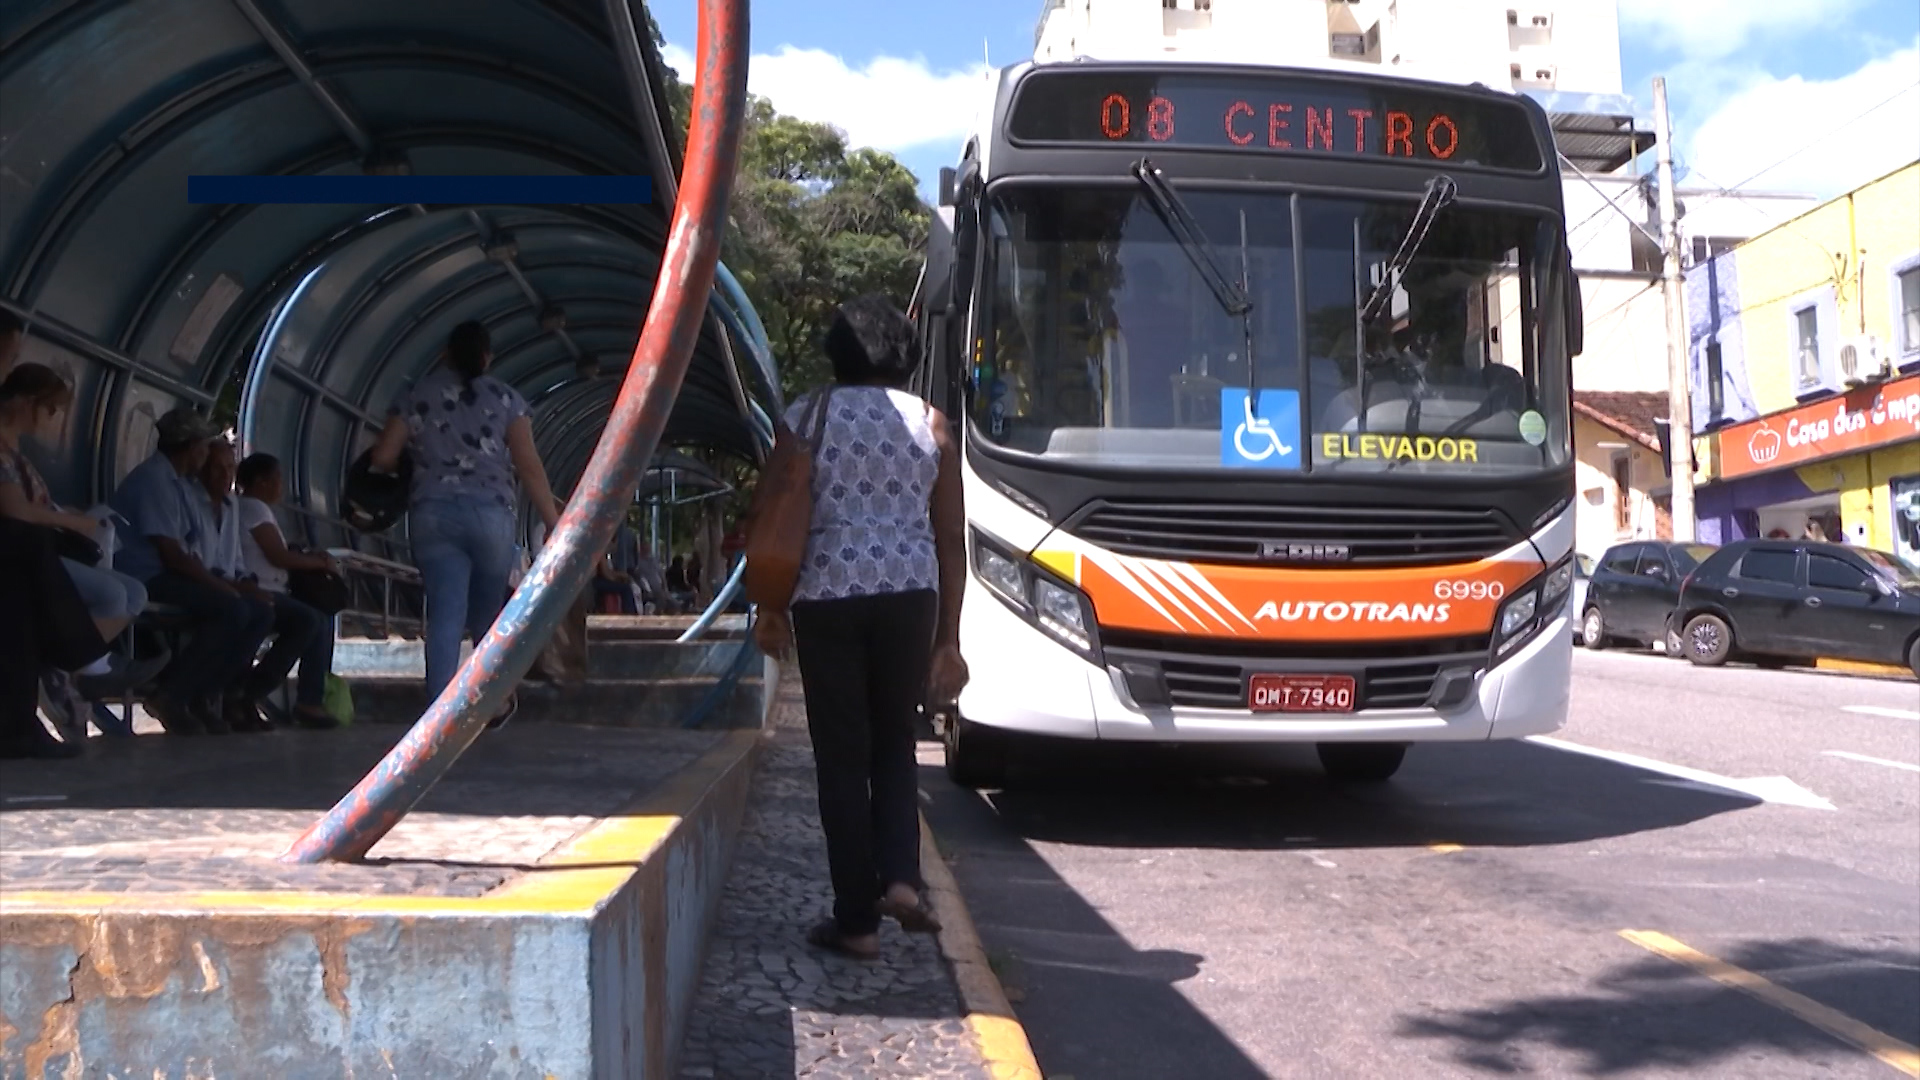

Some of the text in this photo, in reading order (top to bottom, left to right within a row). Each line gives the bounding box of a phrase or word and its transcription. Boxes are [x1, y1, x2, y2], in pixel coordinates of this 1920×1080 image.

[1101, 94, 1459, 159] 08 CENTRO
[1787, 418, 1829, 447] Casa
[1322, 433, 1478, 463] ELEVADOR
[1433, 580, 1504, 600] 6990
[1254, 600, 1451, 623] AUTOTRANS
